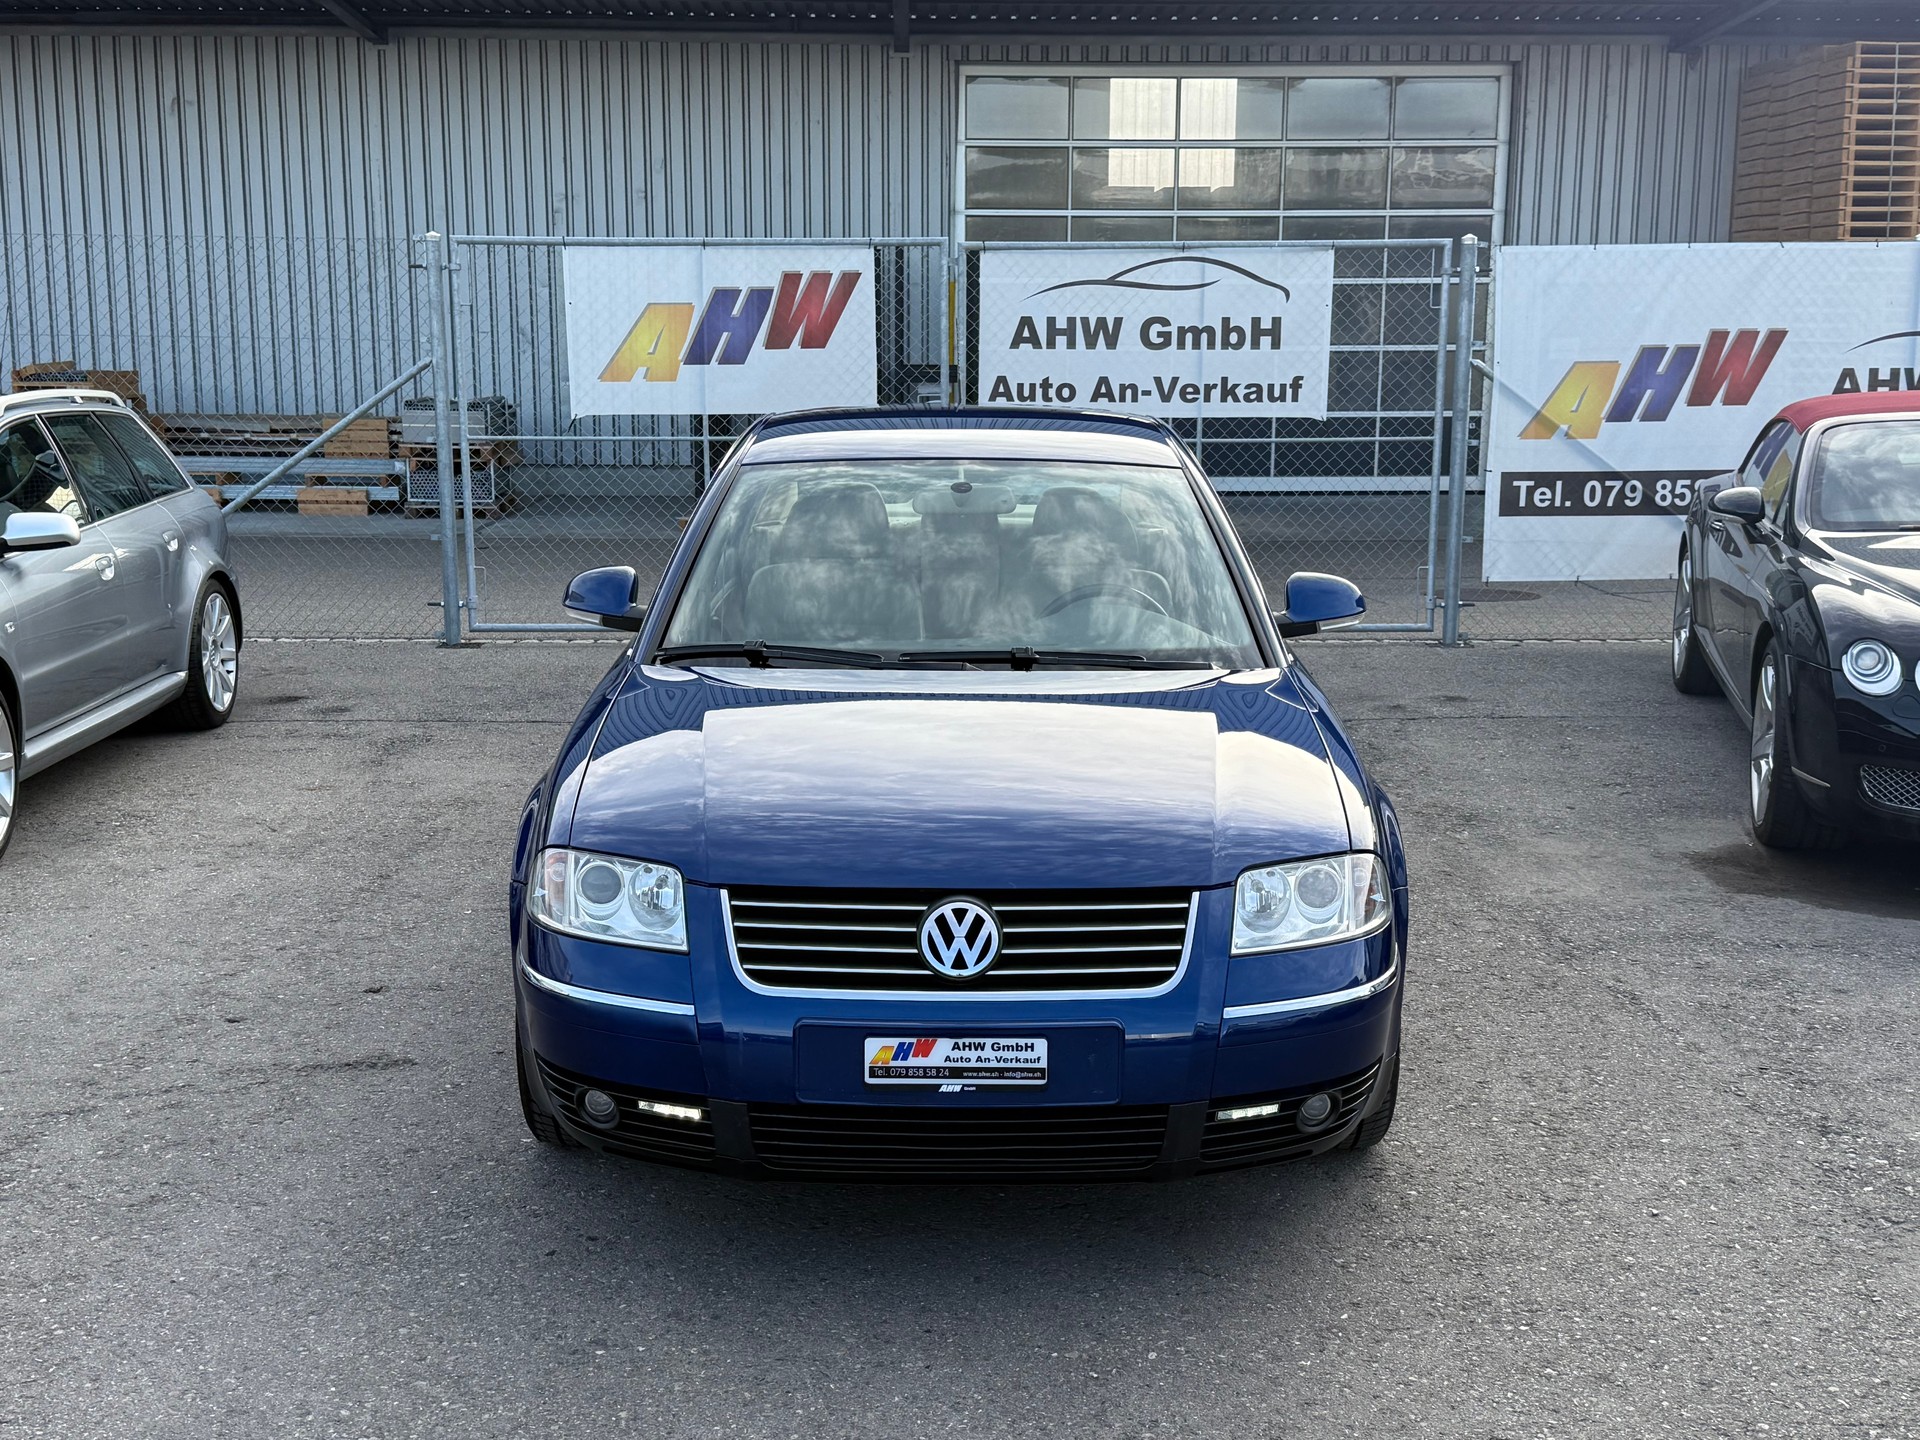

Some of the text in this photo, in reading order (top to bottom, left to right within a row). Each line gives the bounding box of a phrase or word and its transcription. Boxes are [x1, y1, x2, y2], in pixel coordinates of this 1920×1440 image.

[597, 270, 863, 382] AHW
[1009, 316, 1282, 351] AHW GmbH
[988, 375, 1304, 404] Auto An-Verkauf
[1518, 328, 1789, 439] AHW
[1512, 480, 1572, 508] Tel.
[1583, 479, 1643, 508] 079
[869, 1039, 938, 1065] AHW
[944, 1055, 1042, 1065] Auto An-Verkauf
[951, 1041, 1035, 1053] AHW GmbH
[873, 1067, 949, 1077] Tel. 079 858 58 24
[938, 1084, 963, 1093] AHW
